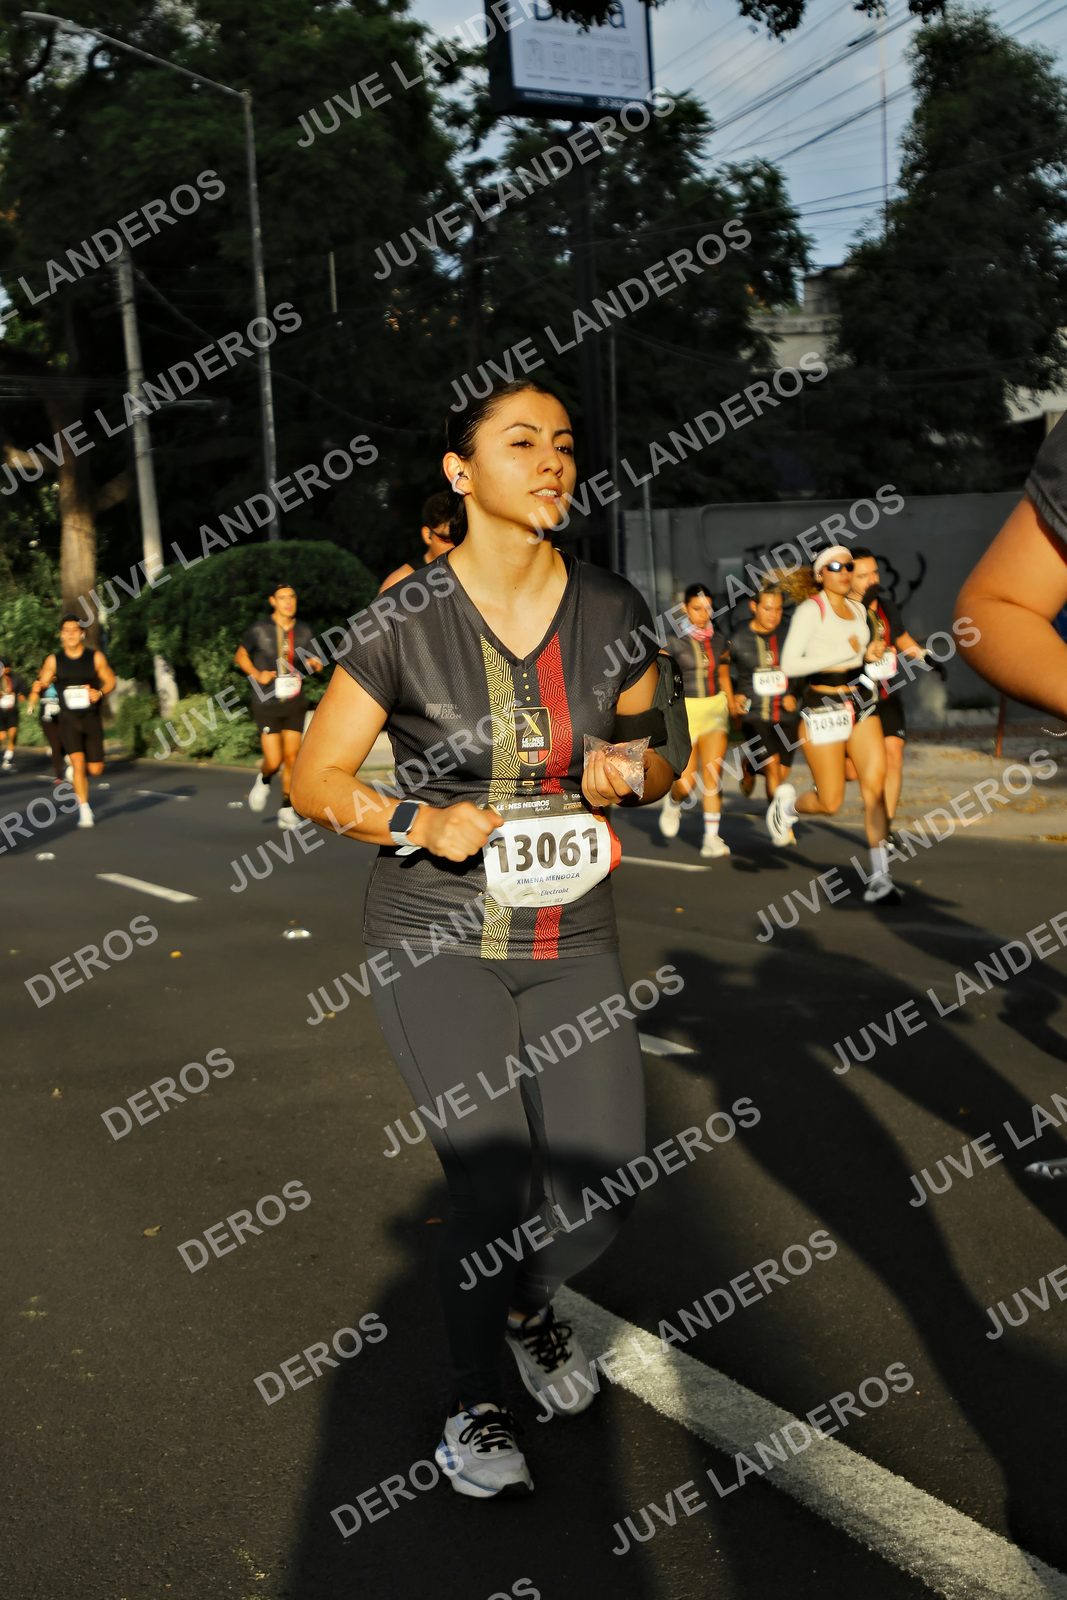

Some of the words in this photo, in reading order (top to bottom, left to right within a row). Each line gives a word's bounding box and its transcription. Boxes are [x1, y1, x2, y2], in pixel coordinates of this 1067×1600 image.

[522, 799, 550, 809] NEGROS
[489, 827, 598, 873] 13061
[516, 877, 544, 885] XIMENA
[545, 872, 580, 882] MENDOZA
